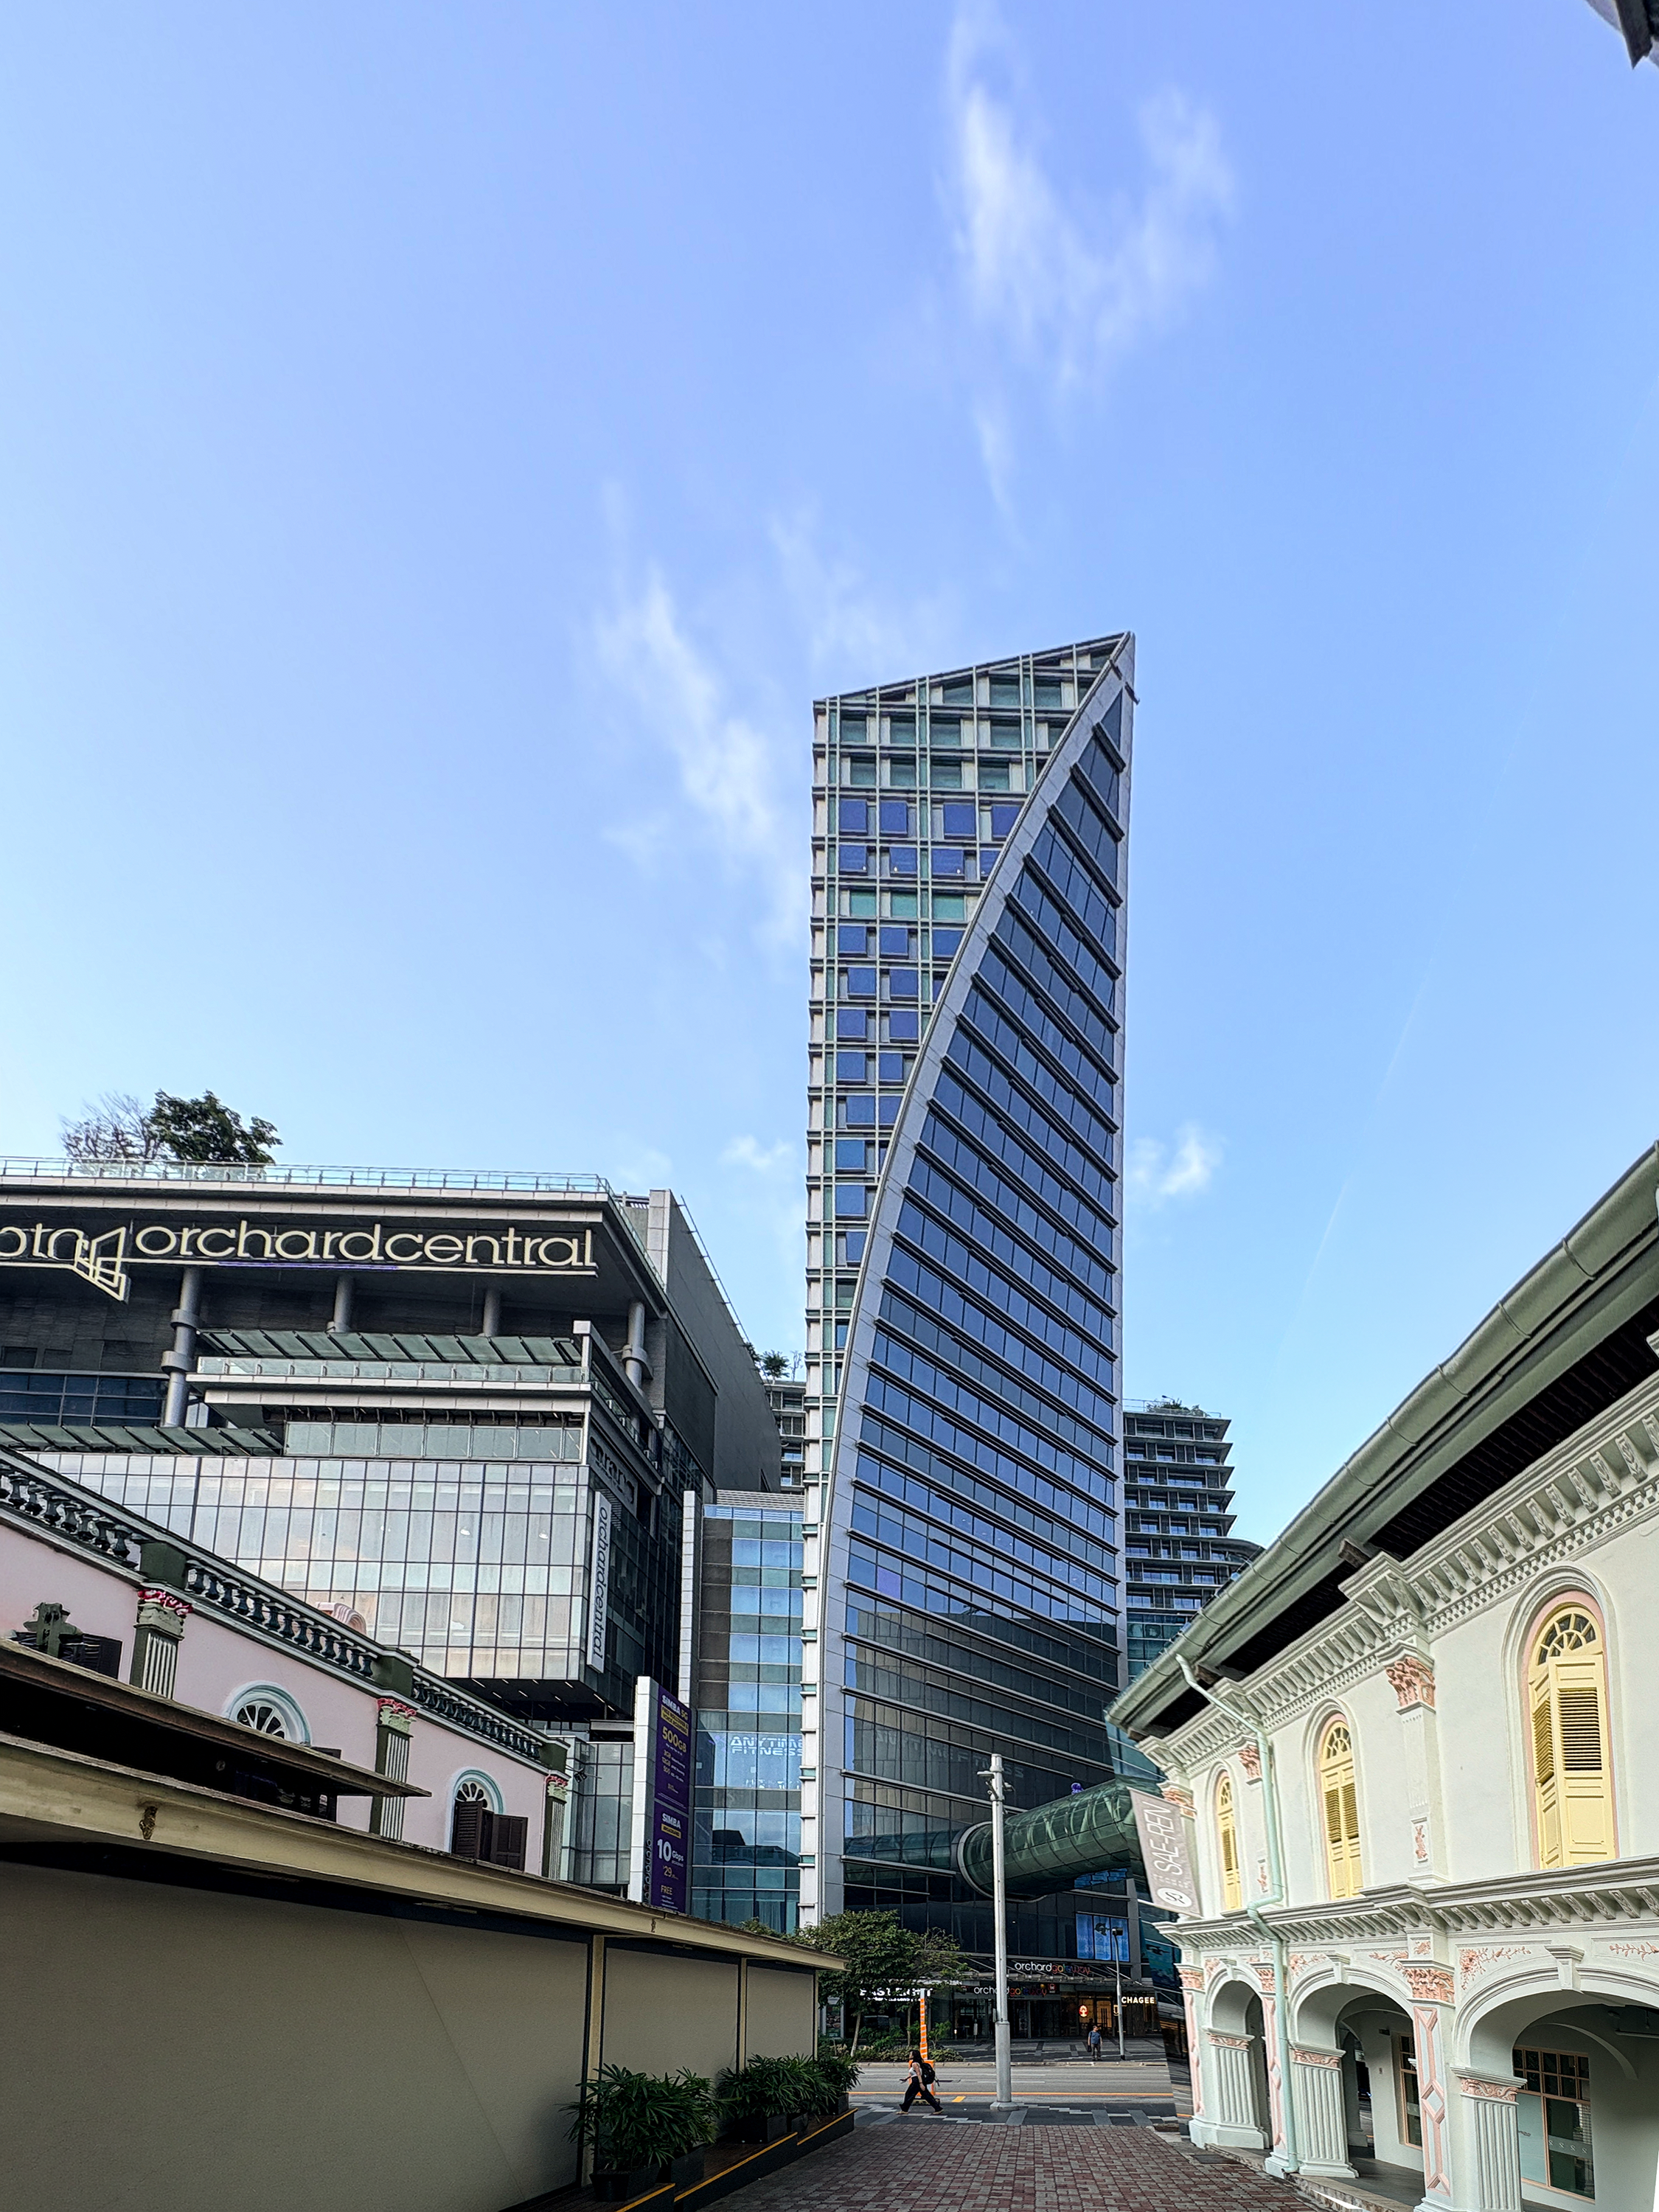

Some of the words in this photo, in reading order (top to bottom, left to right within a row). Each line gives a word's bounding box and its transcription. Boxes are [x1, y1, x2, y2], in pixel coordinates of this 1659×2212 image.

[135, 1220, 598, 1267] orchardcentral
[593, 1506, 608, 1659] orchardcentral
[662, 1726, 687, 1753] 500GB
[662, 1813, 681, 1829] SIMBA
[1142, 1801, 1183, 1876] SAE-REN
[657, 1839, 672, 1862] 10
[1015, 1961, 1091, 1975] orchardgateway
[973, 1984, 1048, 1997] orchdgateway
[1121, 1996, 1155, 2004] CHAGEE
